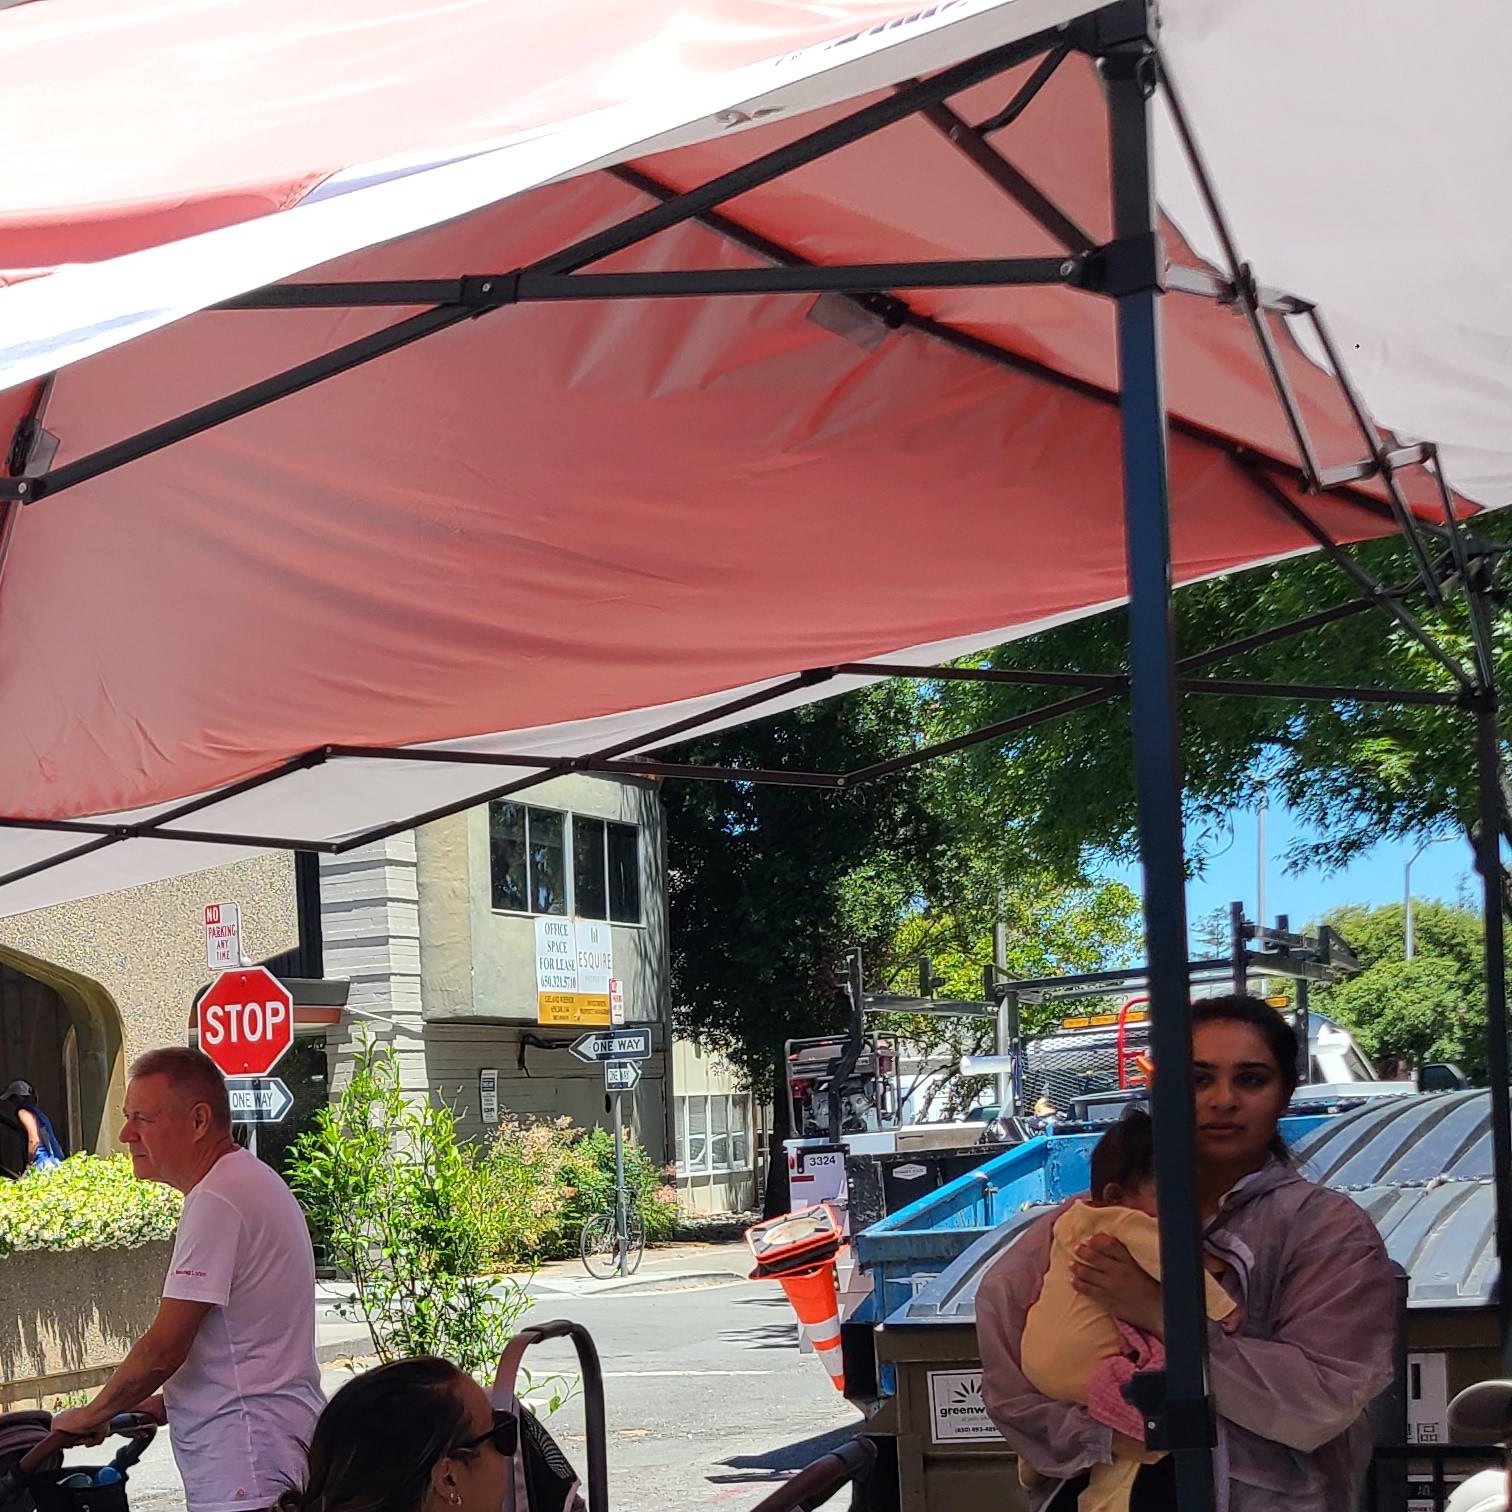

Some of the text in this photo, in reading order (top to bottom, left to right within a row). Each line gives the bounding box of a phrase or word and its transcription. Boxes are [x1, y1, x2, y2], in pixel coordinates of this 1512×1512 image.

[206, 906, 219, 923] NO
[208, 924, 236, 939] PARKING
[544, 922, 568, 936] OFFICE
[216, 940, 229, 949] ANY
[547, 941, 568, 954] SPACE
[216, 951, 230, 960] TIME
[578, 951, 612, 970] ESQUIRE
[539, 957, 576, 971] FOR LEASE
[205, 1001, 285, 1045] STOP
[592, 1039, 640, 1053] ONE WAY
[232, 1091, 273, 1108] ONE WAY
[809, 1155, 836, 1167] 3324
